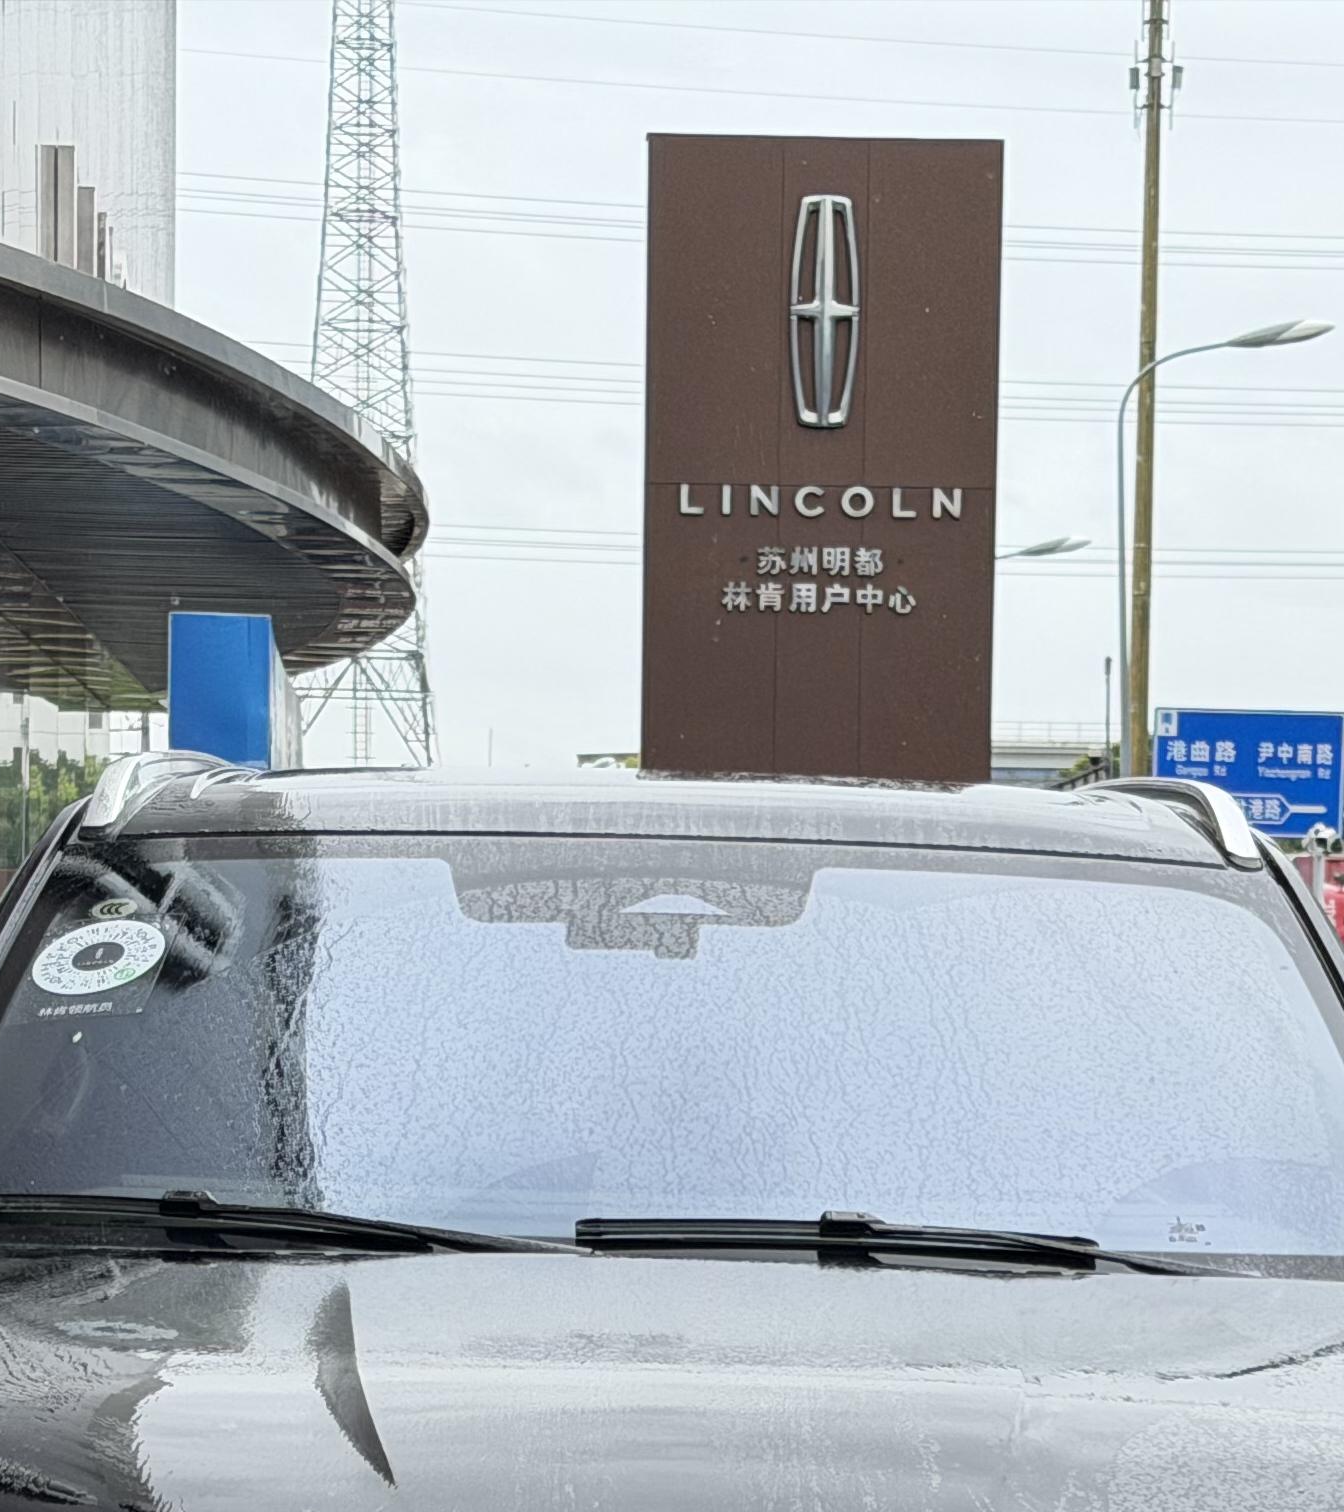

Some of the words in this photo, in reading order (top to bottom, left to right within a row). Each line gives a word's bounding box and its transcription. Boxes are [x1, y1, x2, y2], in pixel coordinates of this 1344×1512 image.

[678, 483, 964, 519] LINCOLN
[756, 546, 884, 578] 苏州明都
[721, 582, 917, 615] 林肯用户中心
